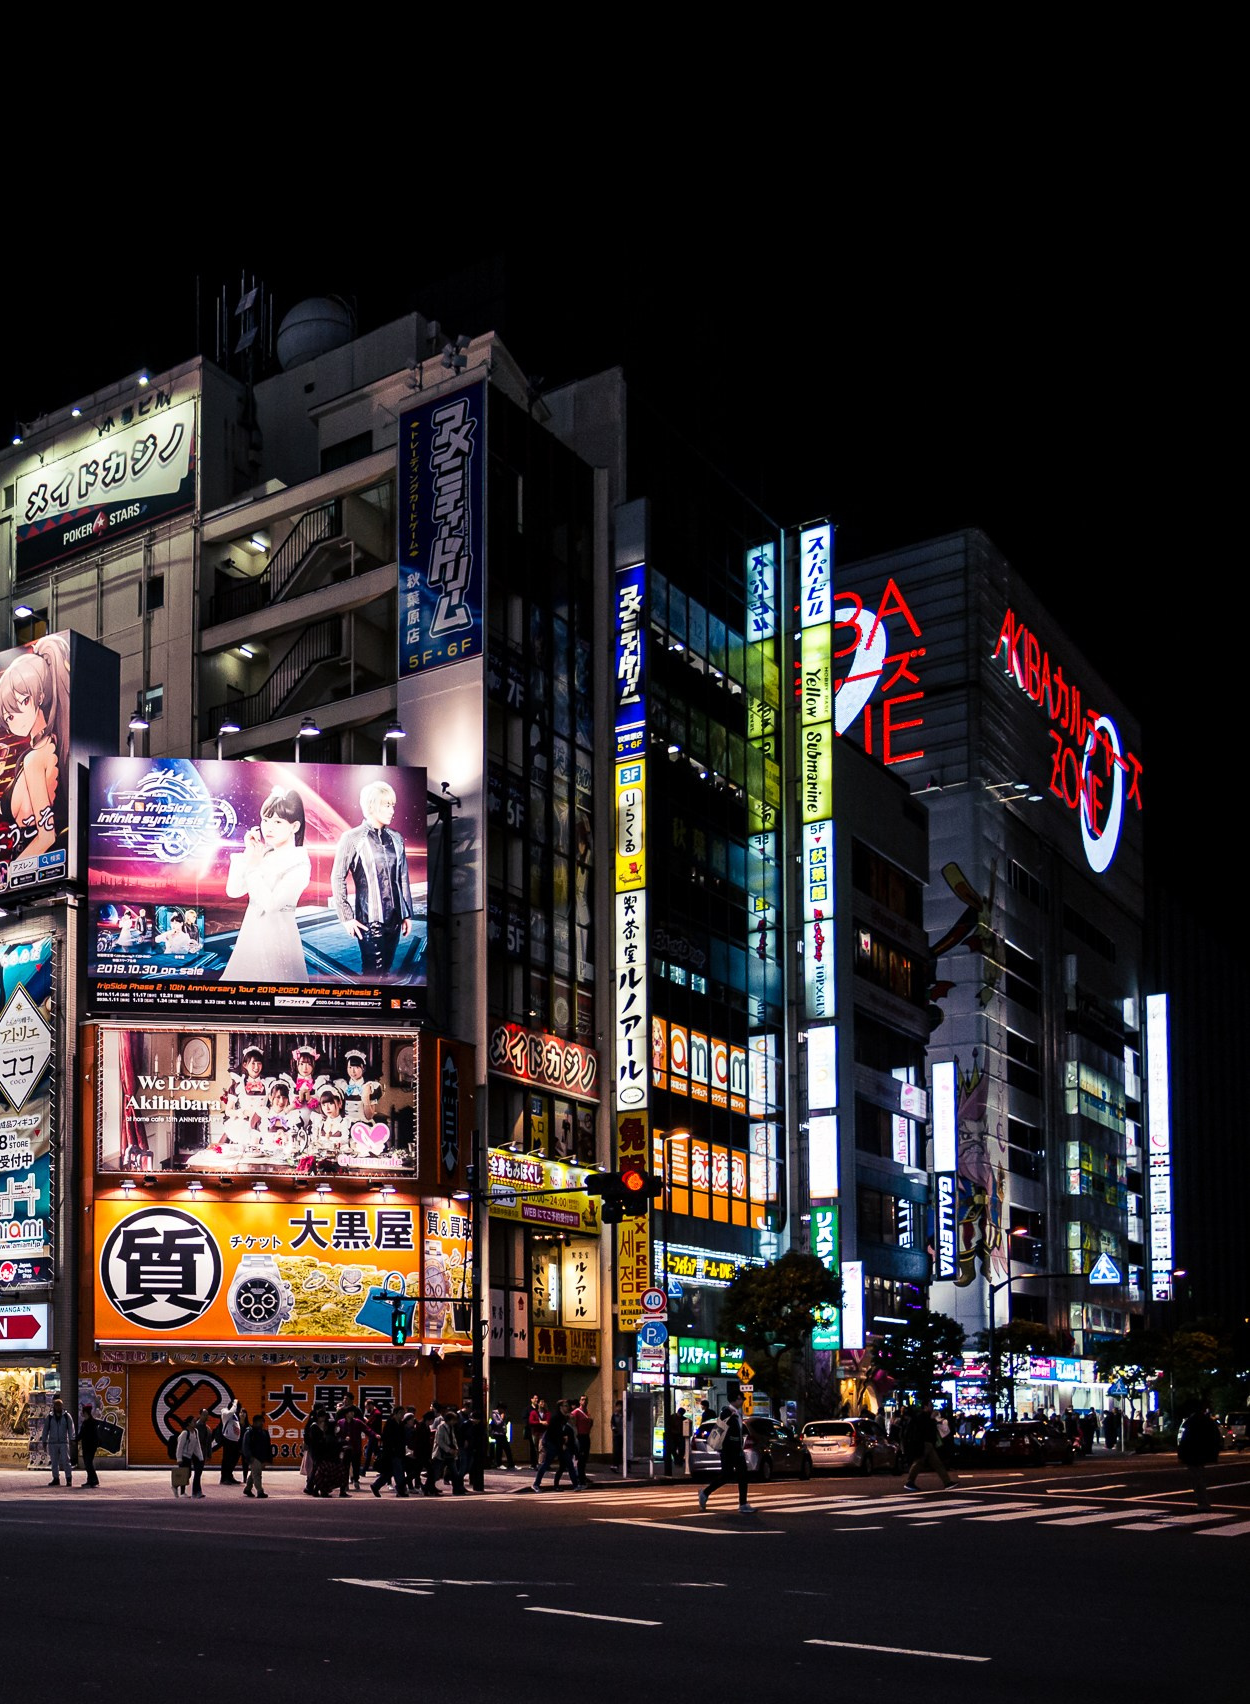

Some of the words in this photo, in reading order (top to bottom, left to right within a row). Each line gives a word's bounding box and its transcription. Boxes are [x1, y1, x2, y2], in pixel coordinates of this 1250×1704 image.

[25, 423, 185, 522] メイドカジノ
[63, 522, 93, 546] POKER
[109, 503, 141, 526] STARS
[806, 534, 825, 619] スーパービル
[405, 572, 420, 645] 秋葉原店
[805, 668, 822, 718] Yellow
[622, 766, 640, 783] 3F
[805, 730, 822, 814] Submarine
[97, 813, 142, 823] infinite
[141, 814, 206, 828] synthesis
[144, 802, 193, 814] fripSide
[625, 792, 636, 854] りらくる
[810, 822, 826, 835] 5F
[506, 924, 525, 954] 5F
[96, 963, 157, 977] 2019.10.30
[159, 965, 175, 976] on
[178, 965, 204, 977] sale
[96, 982, 129, 992] fripSide
[129, 982, 155, 991] Phase
[187, 984, 237, 994] Anniversary
[238, 985, 255, 993] Tour
[332, 988, 372, 998] synthesis
[0, 1025, 40, 1044] アトリエ
[2, 1054, 35, 1079] ココ
[490, 1025, 597, 1092] メイドカジノ
[137, 1074, 166, 1092] We
[167, 1074, 211, 1092] Love
[125, 1095, 222, 1112] Akihabara
[132, 1115, 149, 1123] home
[150, 1115, 165, 1123] cafe
[9, 1141, 29, 1149] STORE
[489, 1155, 541, 1184] 全身もみほぐし
[230, 1235, 282, 1249] チケット
[289, 1208, 414, 1251] 大黒屋
[938, 1176, 954, 1278] GALLERIA
[815, 1211, 834, 1269] リバティ
[116, 1226, 211, 1315] 質
[575, 1261, 588, 1318] ルノアール
[646, 1294, 661, 1306] 40
[646, 1327, 657, 1344] P
[678, 1345, 718, 1365] リバティー
[296, 1365, 367, 1382] チケット
